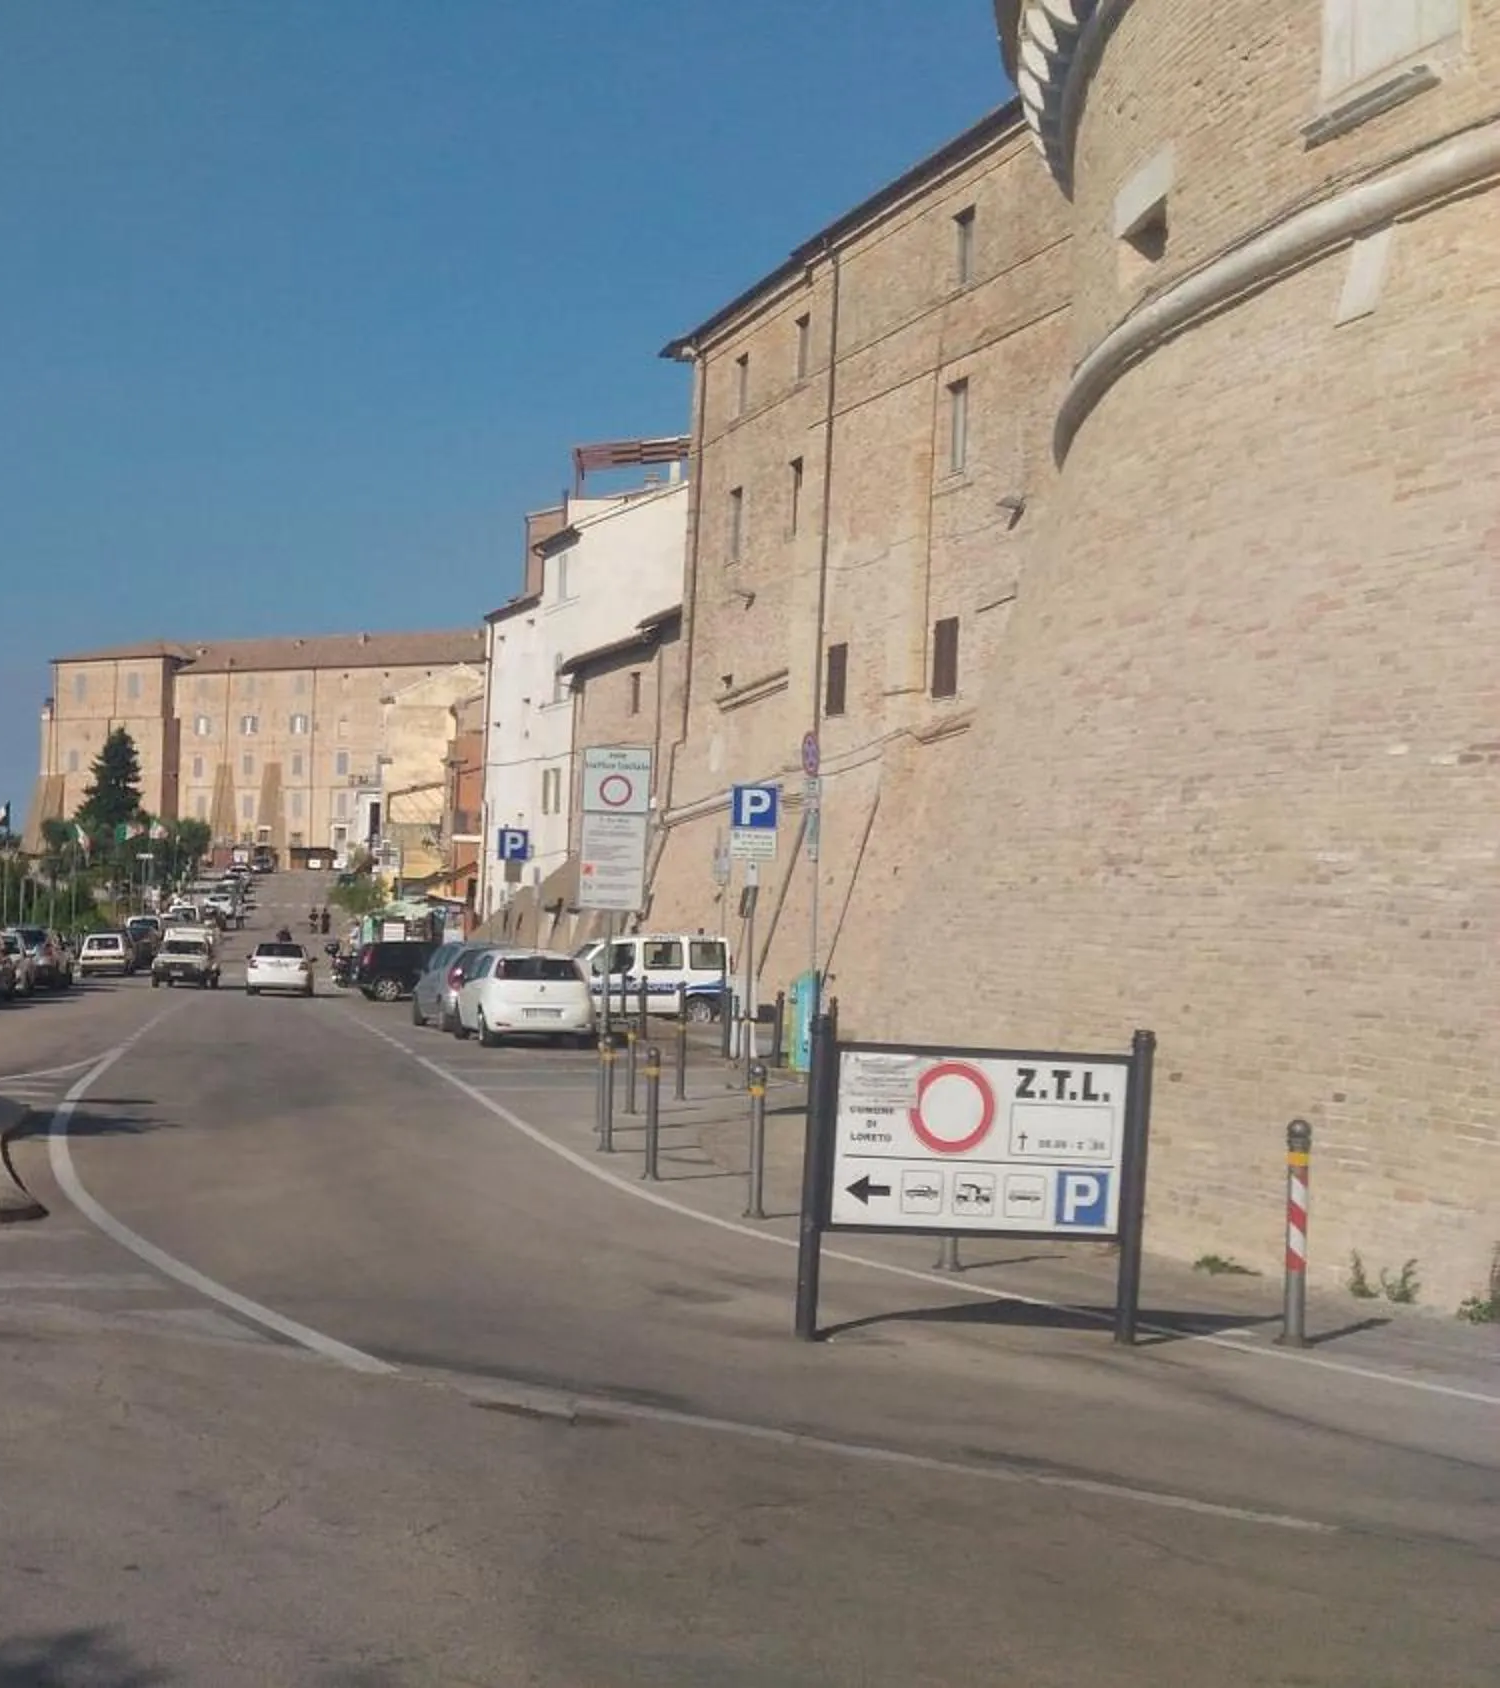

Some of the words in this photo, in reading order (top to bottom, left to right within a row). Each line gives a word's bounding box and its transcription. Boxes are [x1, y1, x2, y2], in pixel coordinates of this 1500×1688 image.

[741, 789, 771, 825] P
[504, 831, 525, 859] P
[1015, 1067, 1111, 1103] Z.T.L.
[850, 1132, 892, 1143] LORETO
[1063, 1175, 1100, 1222] P
